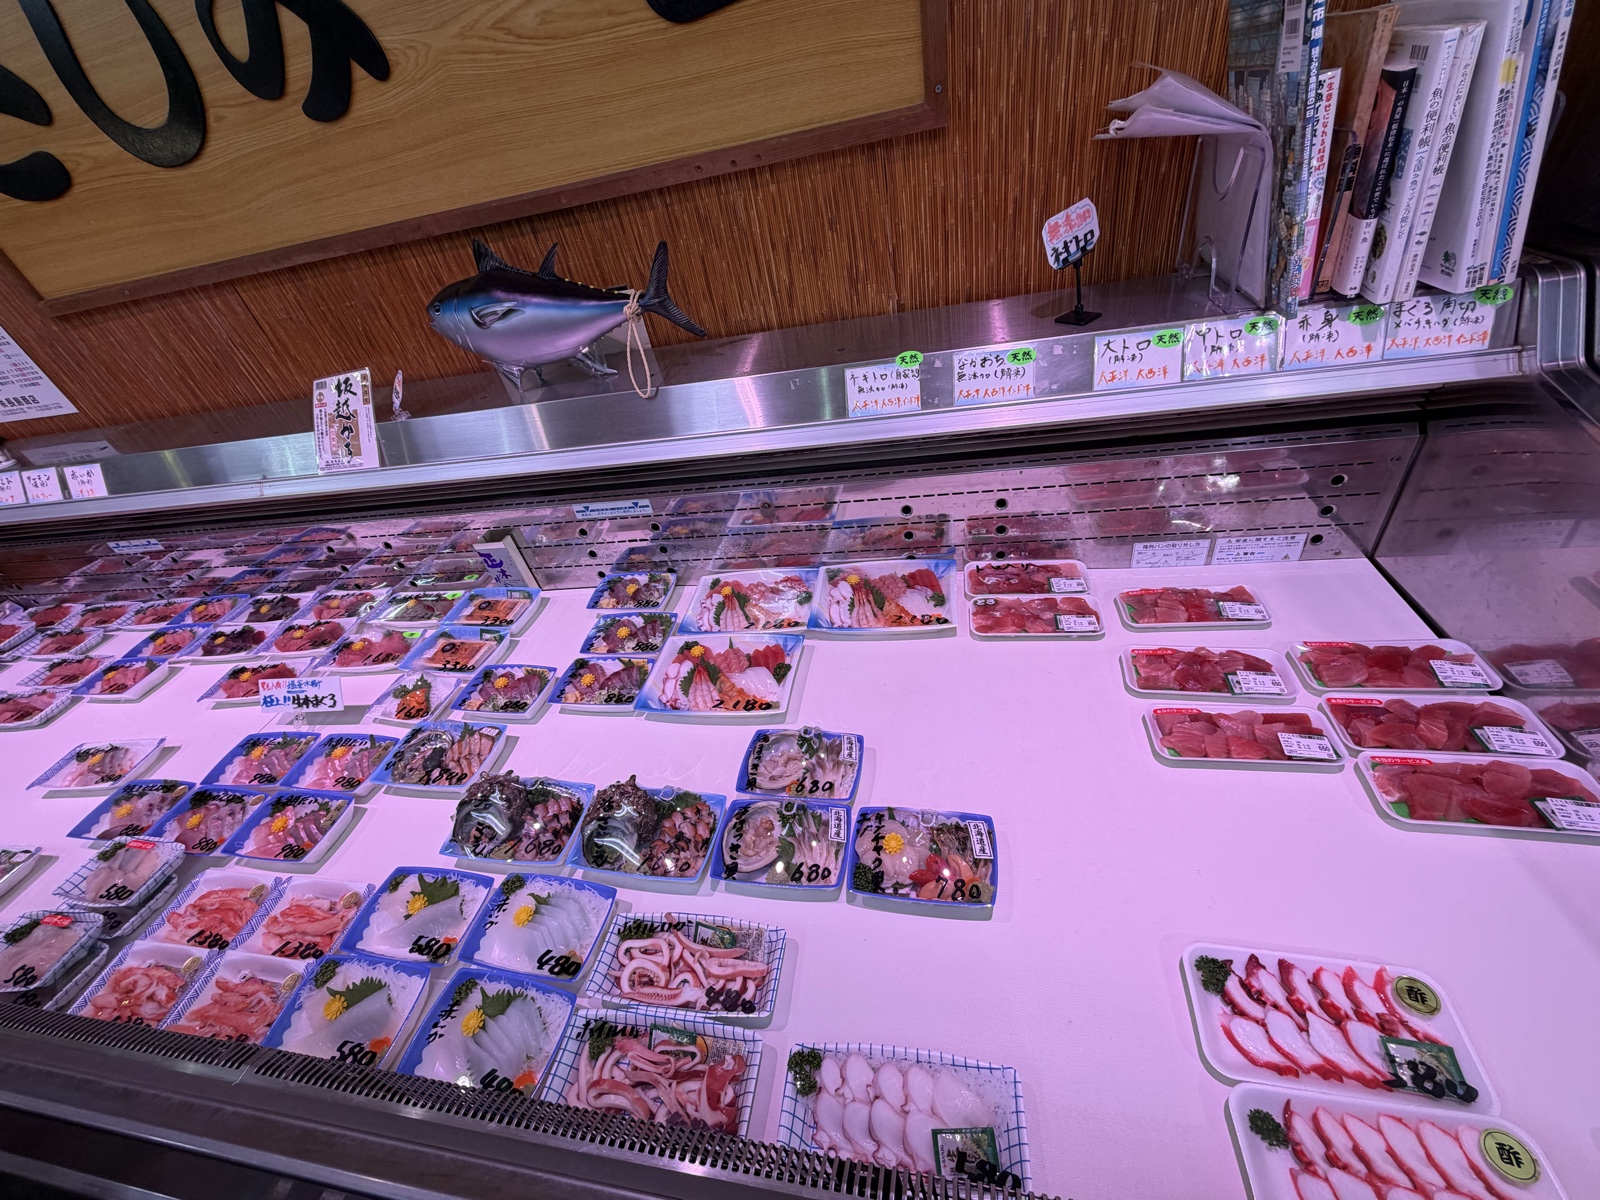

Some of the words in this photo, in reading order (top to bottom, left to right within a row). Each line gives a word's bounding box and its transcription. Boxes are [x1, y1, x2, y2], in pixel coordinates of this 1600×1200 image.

[1417, 87, 1443, 149] 魚の便利帳
[1432, 122, 1456, 175] 魚の便利帳
[1351, 308, 1379, 322] 天然
[1101, 338, 1152, 358] 大トロ
[1154, 332, 1181, 345] 天然
[898, 353, 920, 365] 天然
[1011, 350, 1033, 362] 天然
[332, 776, 361, 788] 980
[795, 776, 833, 794] 680
[832, 809, 845, 839] 北海道産
[972, 823, 989, 855] 北海道産
[274, 844, 305, 858] 980
[790, 862, 832, 883] 680
[99, 883, 134, 900] 580
[935, 874, 981, 902] 780
[408, 935, 451, 959] 580
[536, 949, 584, 976] 480
[1494, 1141, 1525, 1169] 酢
